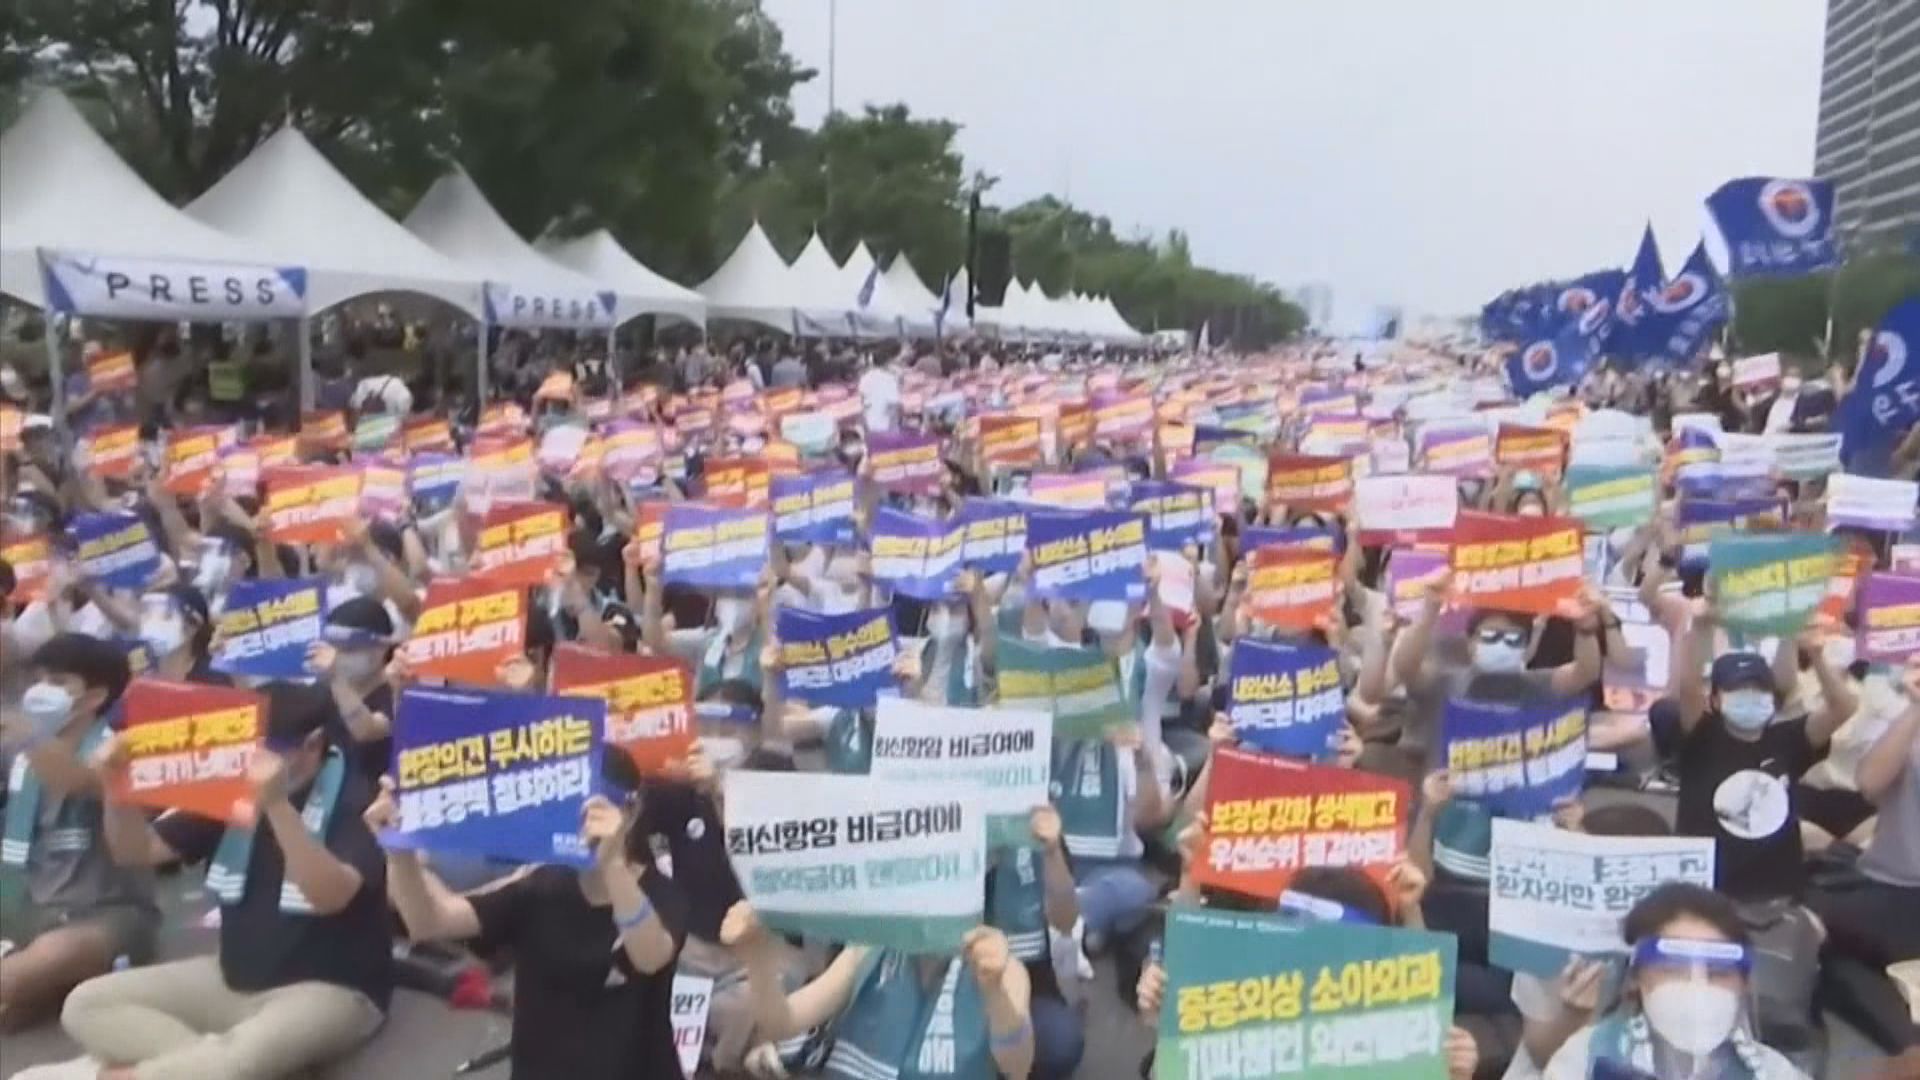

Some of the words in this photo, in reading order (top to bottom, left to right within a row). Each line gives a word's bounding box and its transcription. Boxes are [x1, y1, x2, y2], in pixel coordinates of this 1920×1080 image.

[106, 273, 274, 304] PRESS
[512, 295, 596, 320] PRESS
[398, 735, 487, 788] 현장의견
[488, 714, 592, 769] 무시하는
[874, 735, 942, 759] 최신항암
[950, 729, 1035, 758] 비급여에
[729, 817, 838, 856] 최신항암
[848, 801, 962, 844] 비급여에
[1211, 795, 1311, 834] 보장성강화
[1497, 876, 1596, 911] 환자위한
[1177, 970, 1304, 1031] 중증외상
[1310, 949, 1443, 1013] 소아외과
